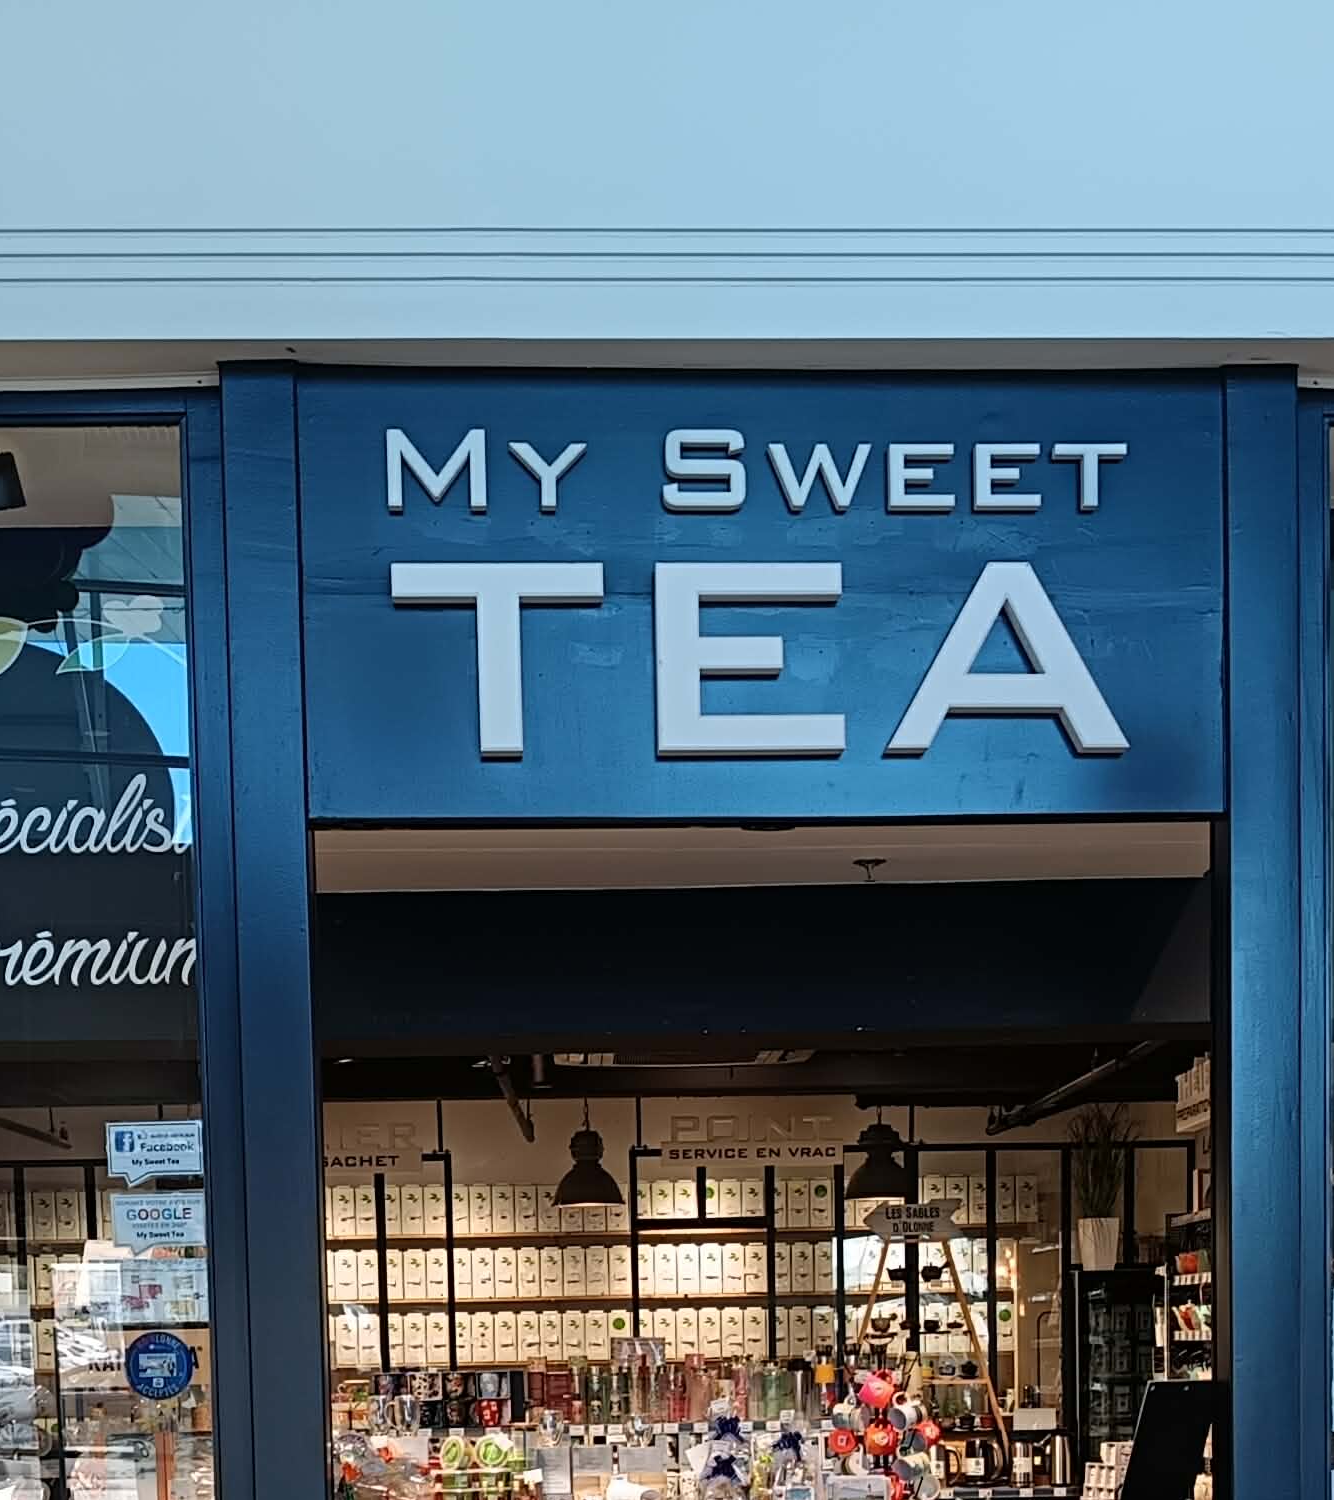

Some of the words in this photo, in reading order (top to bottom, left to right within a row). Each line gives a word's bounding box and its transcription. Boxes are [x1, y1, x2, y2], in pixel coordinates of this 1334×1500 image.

[389, 560, 1131, 760] TEA
[670, 1114, 837, 1143] POINT
[140, 1142, 194, 1153] Facebook
[669, 1148, 748, 1160] SERVICE
[756, 1147, 781, 1158] EN
[788, 1146, 836, 1158] VRAC
[126, 1207, 193, 1221] GOOGLE
